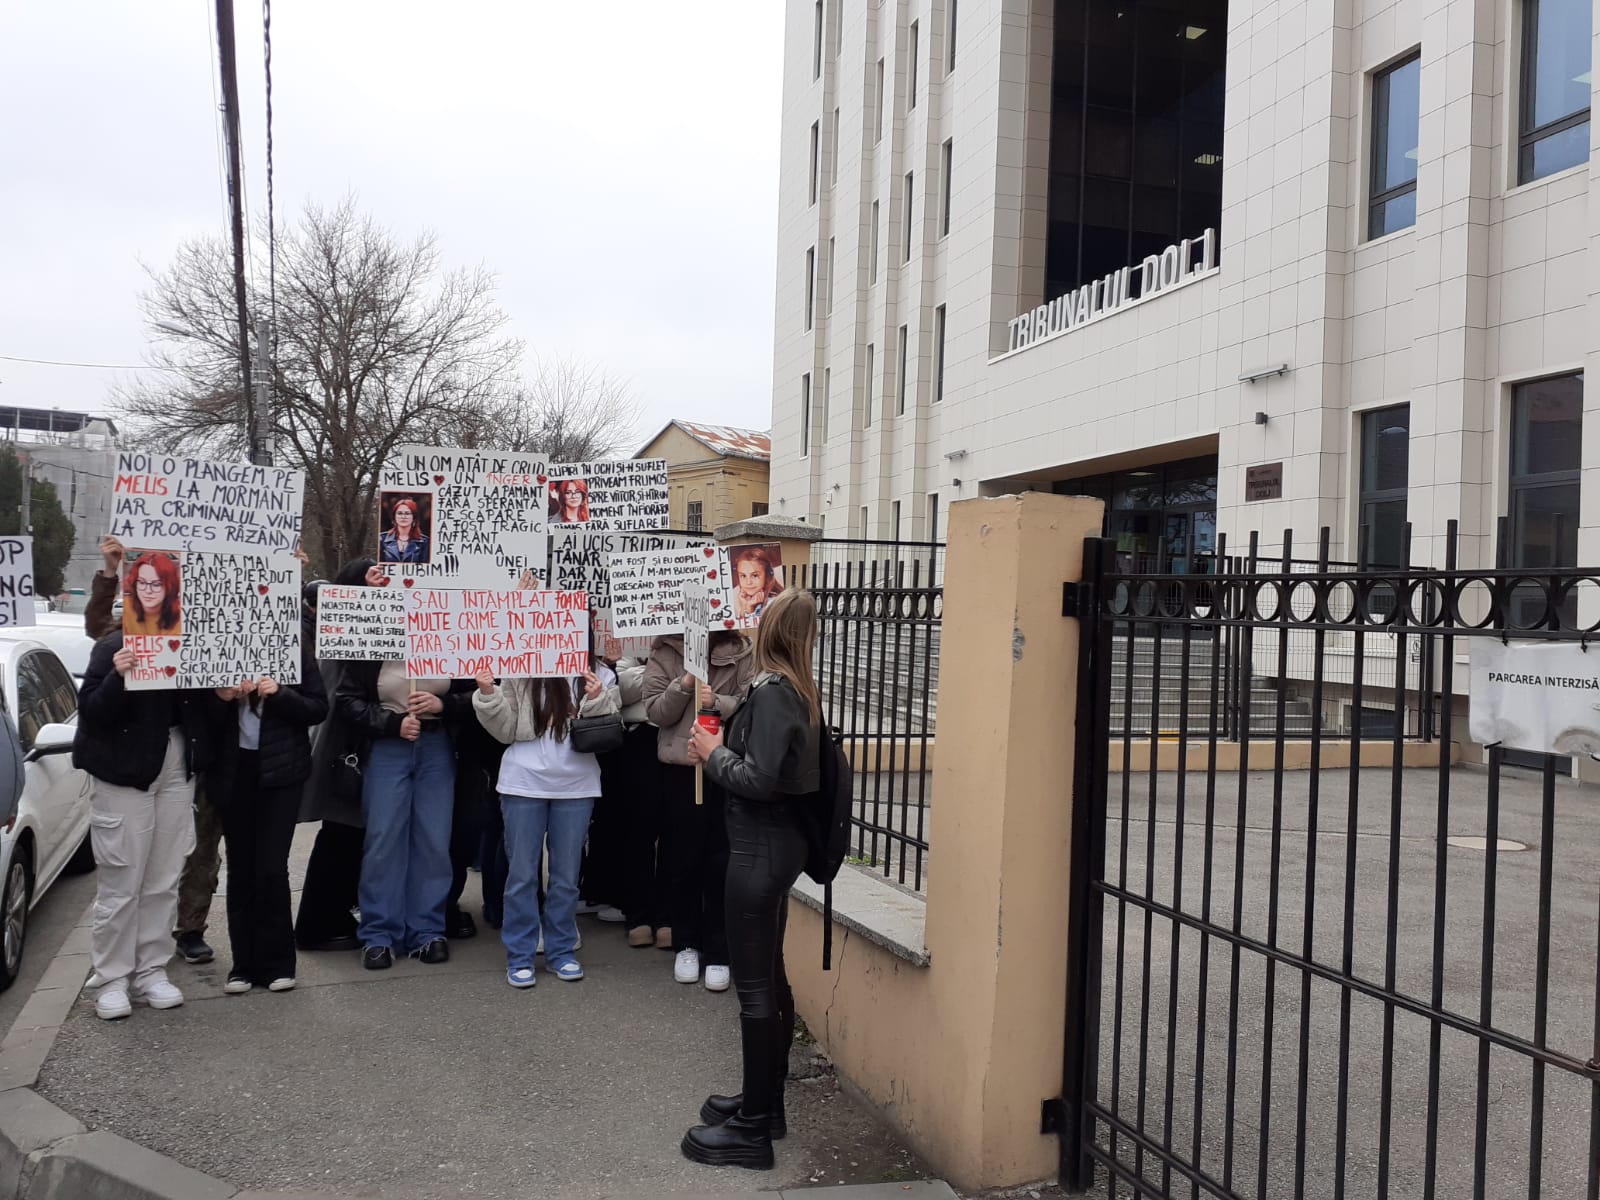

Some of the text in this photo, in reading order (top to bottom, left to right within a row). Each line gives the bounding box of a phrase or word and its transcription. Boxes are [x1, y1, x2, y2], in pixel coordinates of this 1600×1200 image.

[1008, 227, 1216, 352] TRIBUNALUL DOLJ
[406, 455, 425, 471] UN
[430, 455, 452, 472] OM
[456, 453, 488, 473] ATÂT
[490, 459, 508, 474] DE
[594, 462, 615, 474] OCHI
[635, 460, 666, 472] SUFLET
[119, 453, 152, 474] NOI
[163, 458, 175, 475] O
[272, 469, 297, 489] PE
[384, 471, 429, 486] MELIS
[455, 472, 475, 485] UN
[588, 473, 667, 489] PRIVEAM FRUMOS
[114, 473, 296, 512] MELIS LA MORMÂNT
[483, 486, 499, 499] LA
[588, 491, 609, 503] SPRE
[116, 496, 302, 532] IAR CRIMINALUL VINE
[438, 509, 455, 522] DE
[589, 505, 624, 518] MOMENT
[111, 519, 216, 540] LA PROCES
[440, 520, 542, 533] A FOST TRAGIC
[614, 518, 659, 531] SUFLARE
[563, 532, 576, 549] AI
[583, 533, 614, 552] UCIS
[437, 543, 454, 555] DE
[187, 553, 269, 569] EA N-A MAI
[496, 554, 527, 567] UNEI
[610, 559, 622, 567] AM
[627, 557, 646, 565] FOST
[234, 567, 293, 585] PIERDUT
[381, 564, 397, 576] TE
[508, 568, 546, 580] FIRE
[557, 567, 586, 580] DAR
[673, 566, 707, 576] BUCURAT
[183, 579, 255, 595] PRIVIREA
[263, 595, 271, 608] A
[277, 593, 298, 608] MAI
[322, 588, 357, 599] MELIS
[360, 592, 366, 600] A
[412, 591, 448, 610] S-AU
[554, 590, 590, 611] FOARTE
[614, 594, 628, 602] DAR
[321, 601, 362, 611] NOASTRĂ
[616, 604, 636, 615] DATĂ
[251, 608, 274, 621] N-A
[279, 609, 299, 621] MAI
[383, 617, 396, 625] CU
[407, 611, 452, 632] MULTE
[458, 610, 500, 631] CRIME
[507, 610, 525, 629] ÎN
[616, 614, 679, 628] VA FI ATÂT DE
[249, 621, 289, 634] CE-AU
[349, 627, 361, 635] AL
[363, 626, 383, 635] UNEI
[125, 636, 163, 653] MELIS
[182, 634, 205, 647] ZIS
[232, 634, 253, 648] NU
[259, 634, 299, 649] VEDEA
[370, 638, 396, 648] URMĂ
[467, 633, 486, 651] NU
[490, 631, 516, 651] S-A
[519, 630, 584, 650] SCHIMBAT
[180, 648, 211, 661] CUM
[219, 648, 236, 660] AU
[320, 648, 404, 660] DISPERATĂ PENTRU
[137, 655, 156, 668] TE
[179, 661, 232, 674] SICRIUL
[456, 655, 494, 677] DOAR
[131, 667, 166, 681] IUBIM
[176, 675, 191, 688] UN
[1489, 672, 1600, 690] PARCAREA INTERZISĂ
